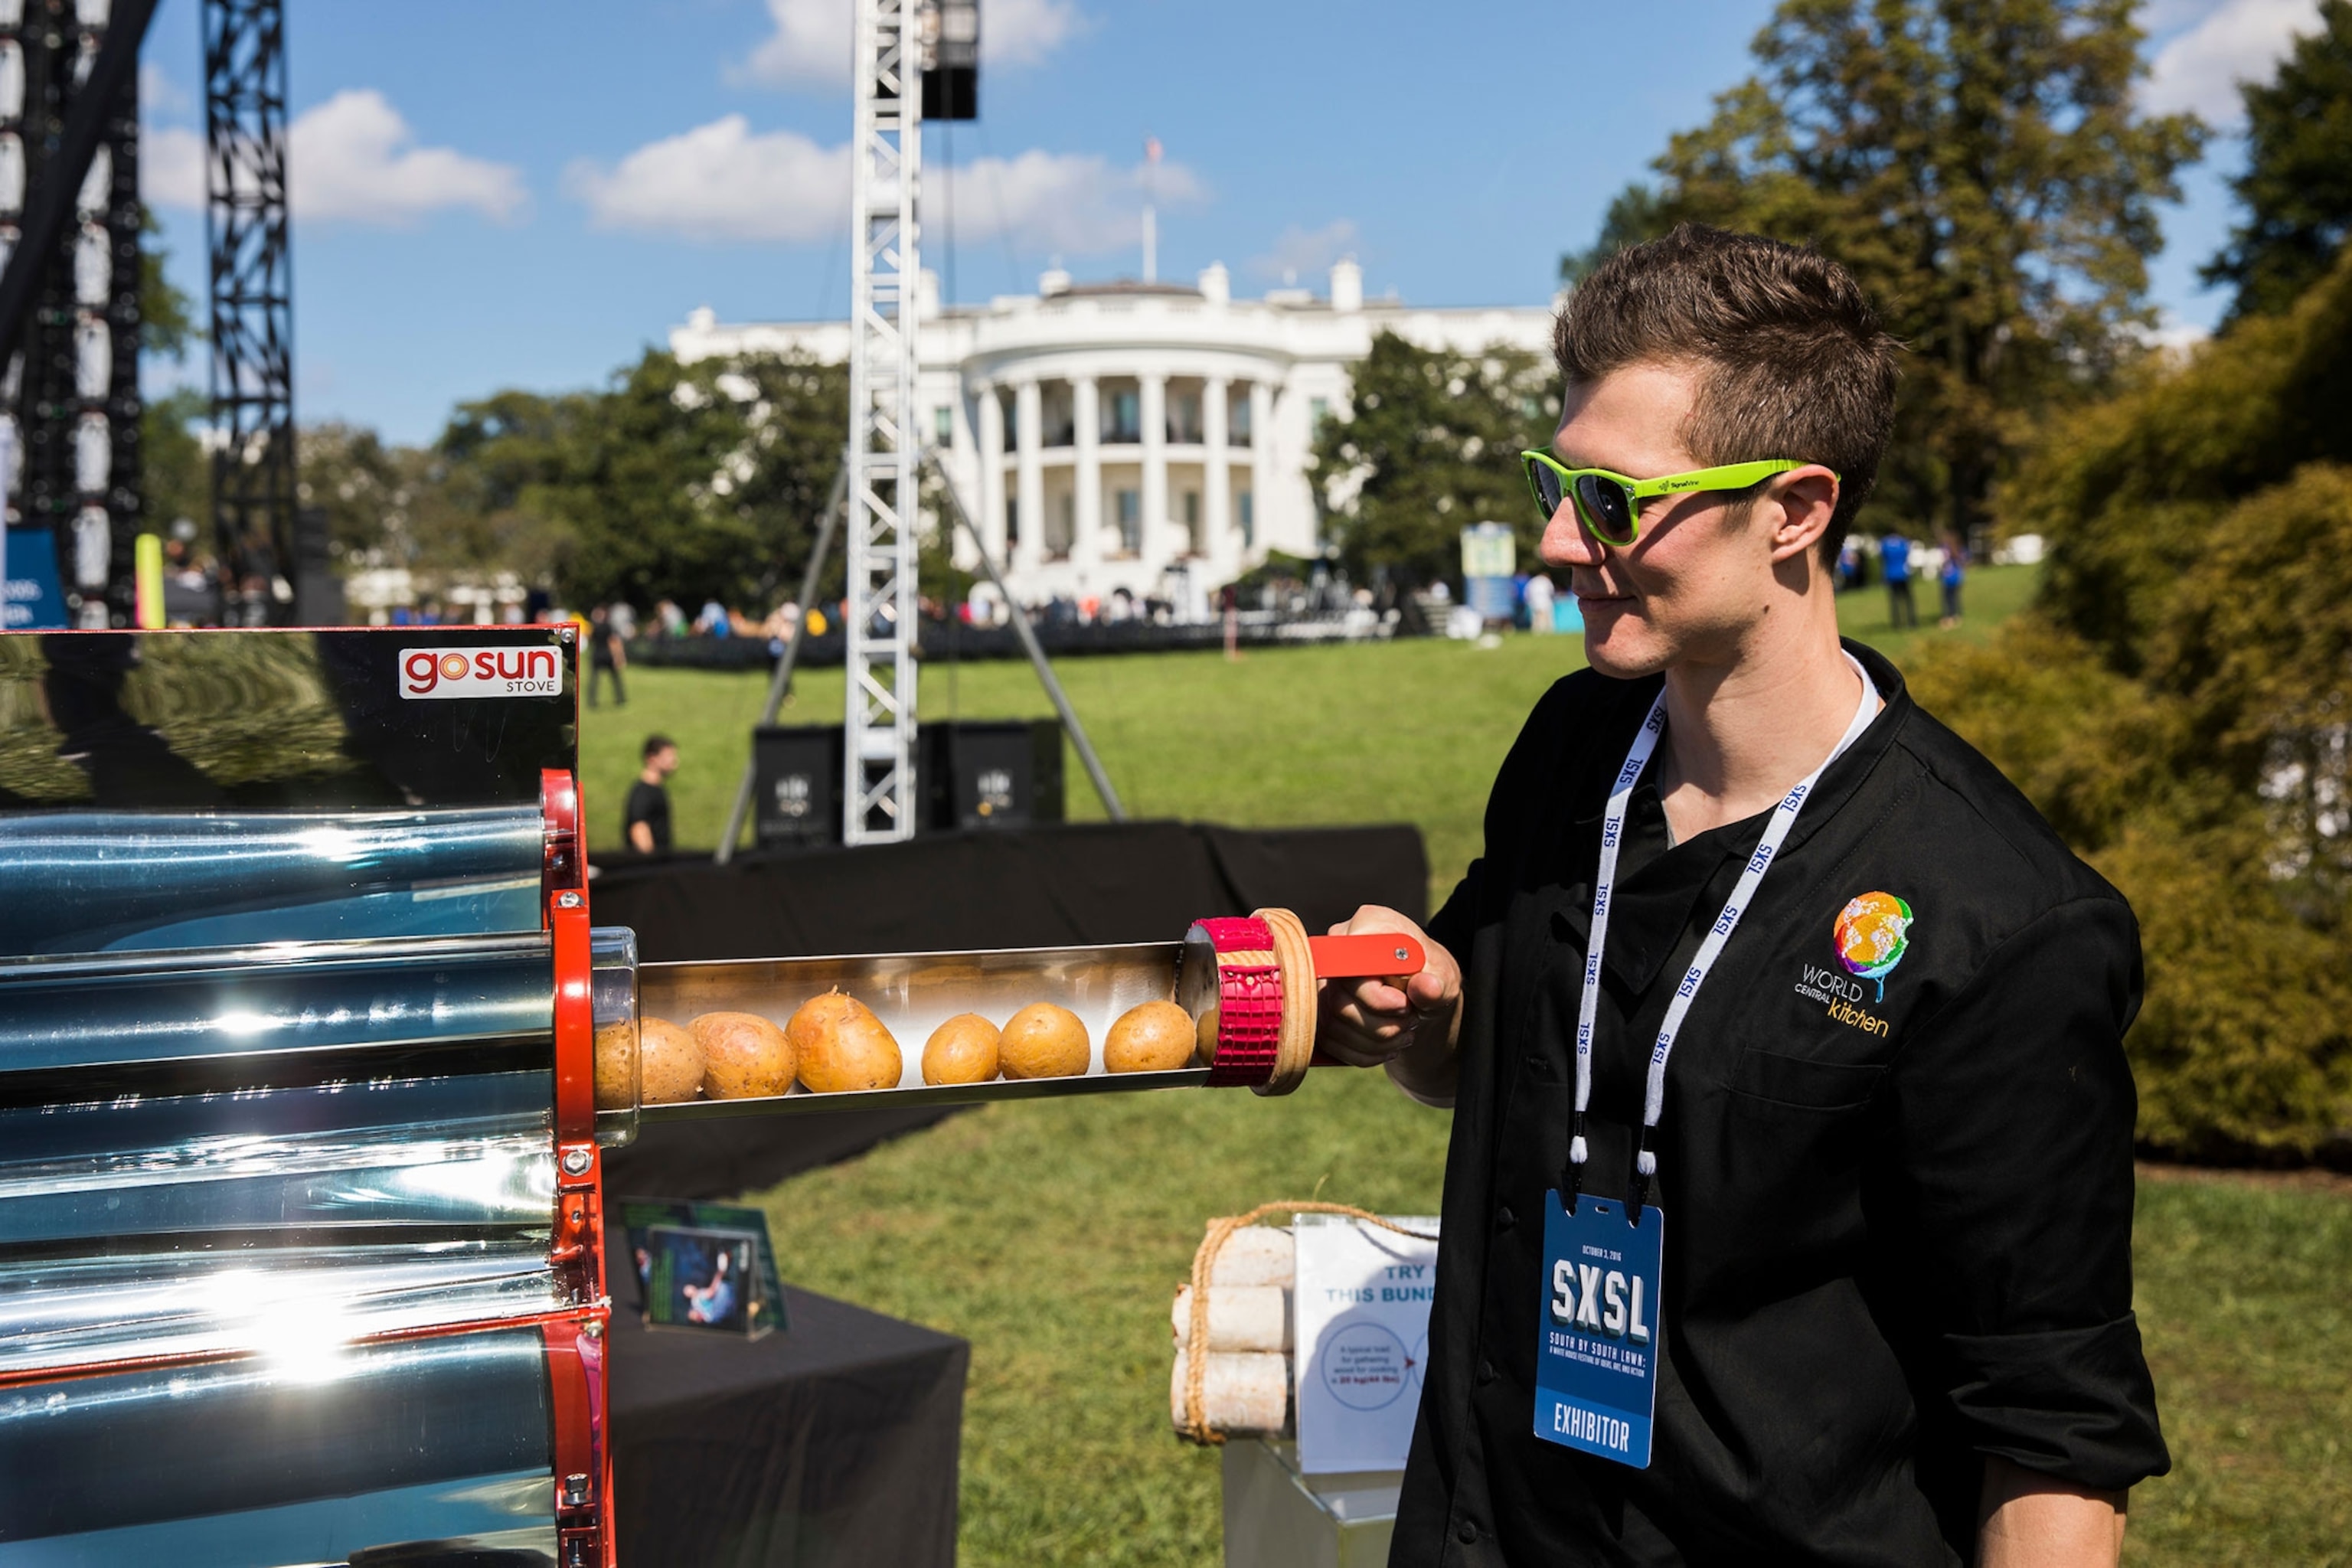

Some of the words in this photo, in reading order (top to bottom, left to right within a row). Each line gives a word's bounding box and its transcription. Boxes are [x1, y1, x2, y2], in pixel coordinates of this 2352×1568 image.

[507, 681, 555, 692] STOVE
[1647, 705, 1666, 733] SXSL
[1619, 758, 1644, 785] SXSL
[1780, 784, 1807, 812] SXSL
[1604, 815, 1621, 848] SXSL
[1746, 844, 1772, 874] SXSL
[1595, 883, 1609, 916] SXSL
[1712, 905, 1738, 936] SXSL
[1586, 952, 1599, 985] SXSL
[1677, 967, 1701, 998] SXSL
[1802, 963, 1863, 1002] WORLD
[1794, 983, 1831, 1004] CENTRAL
[1578, 1022, 1590, 1054] SXSL
[1651, 1033, 1670, 1064] SXSL
[1583, 1244, 1603, 1258] OCTOBER
[1609, 1250, 1622, 1262] 2016
[1385, 1265, 1426, 1279] TRY
[1325, 1288, 1374, 1302] THIS
[1552, 1259, 1649, 1341] SXSL
[1550, 1331, 1576, 1349] SOUTH
[1579, 1338, 1589, 1352] BY
[1591, 1342, 1618, 1360] SOUTH
[1620, 1349, 1646, 1367] LAWN:
[1554, 1402, 1630, 1452] EXHIBITOR
